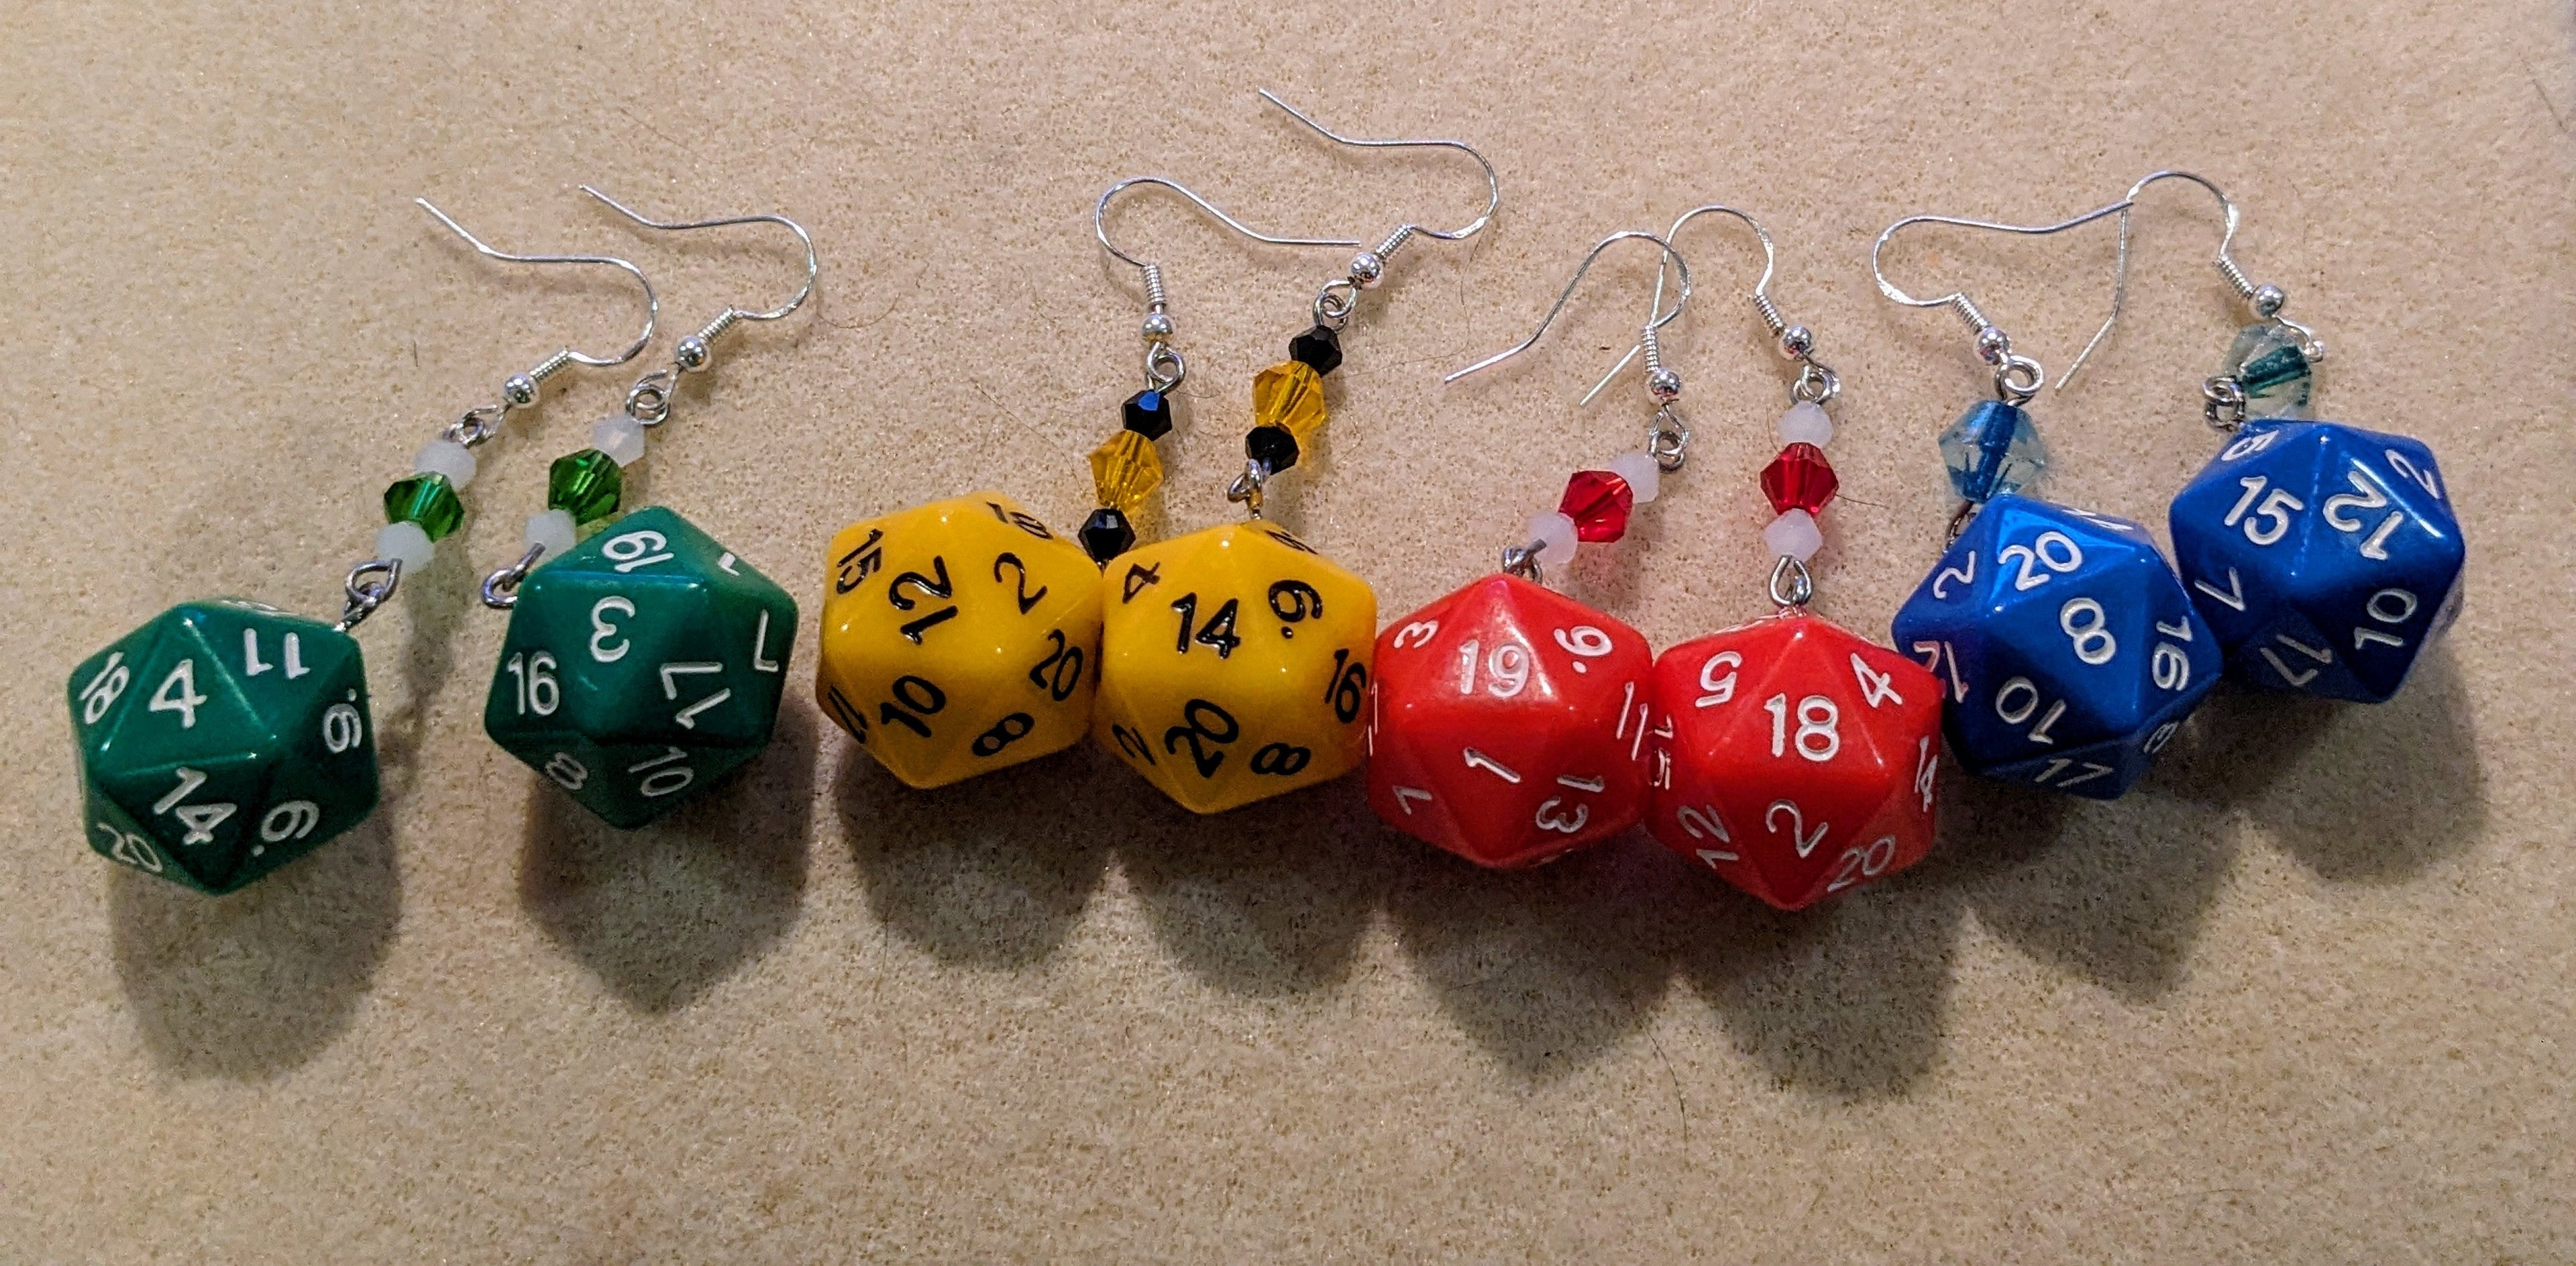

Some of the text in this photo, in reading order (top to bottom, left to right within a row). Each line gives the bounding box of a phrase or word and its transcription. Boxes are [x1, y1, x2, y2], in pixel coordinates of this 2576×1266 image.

[2385, 449, 2440, 500] 2
[2224, 476, 2304, 545] 15
[2322, 471, 2404, 560] 12
[602, 531, 674, 572] 19
[836, 528, 884, 594] 15
[1933, 550, 1976, 600] 2
[1998, 531, 2083, 592] 20
[888, 555, 959, 645] 12
[994, 551, 1048, 615] 2
[1122, 561, 1161, 604] 4
[2194, 567, 2245, 612] 7
[590, 596, 635, 663] 3
[1170, 592, 1241, 660] 14
[1393, 619, 1439, 649] 3
[2060, 596, 2117, 666] 8
[2353, 588, 2418, 650] 10
[243, 628, 311, 680] 11
[506, 650, 559, 717] 16
[1029, 629, 1084, 702] 20
[1458, 639, 1530, 698] 19
[1695, 651, 1742, 708] 5
[1849, 652, 1903, 709] 4
[2151, 615, 2194, 692] 16
[2259, 633, 2333, 688] 17
[148, 658, 207, 728] 4
[660, 662, 731, 729] 17
[880, 675, 947, 738] 10
[1324, 647, 1367, 723] 16
[1995, 676, 2068, 745] 10
[971, 712, 1035, 757] 8
[1165, 698, 1239, 779] 20
[1615, 681, 1650, 761] 11
[1764, 692, 1840, 762] 18
[544, 751, 588, 790] 8
[628, 746, 694, 797] 10
[1250, 742, 1311, 776] 8
[1463, 747, 1522, 784] 1
[2035, 757, 2113, 788] 17
[154, 767, 237, 846] 14
[1392, 785, 1432, 815] 7
[1535, 774, 1606, 833] 13
[1765, 798, 1829, 858] 2
[97, 823, 163, 872] 20
[1678, 804, 1739, 869] 12
[1827, 835, 1896, 892] 20
